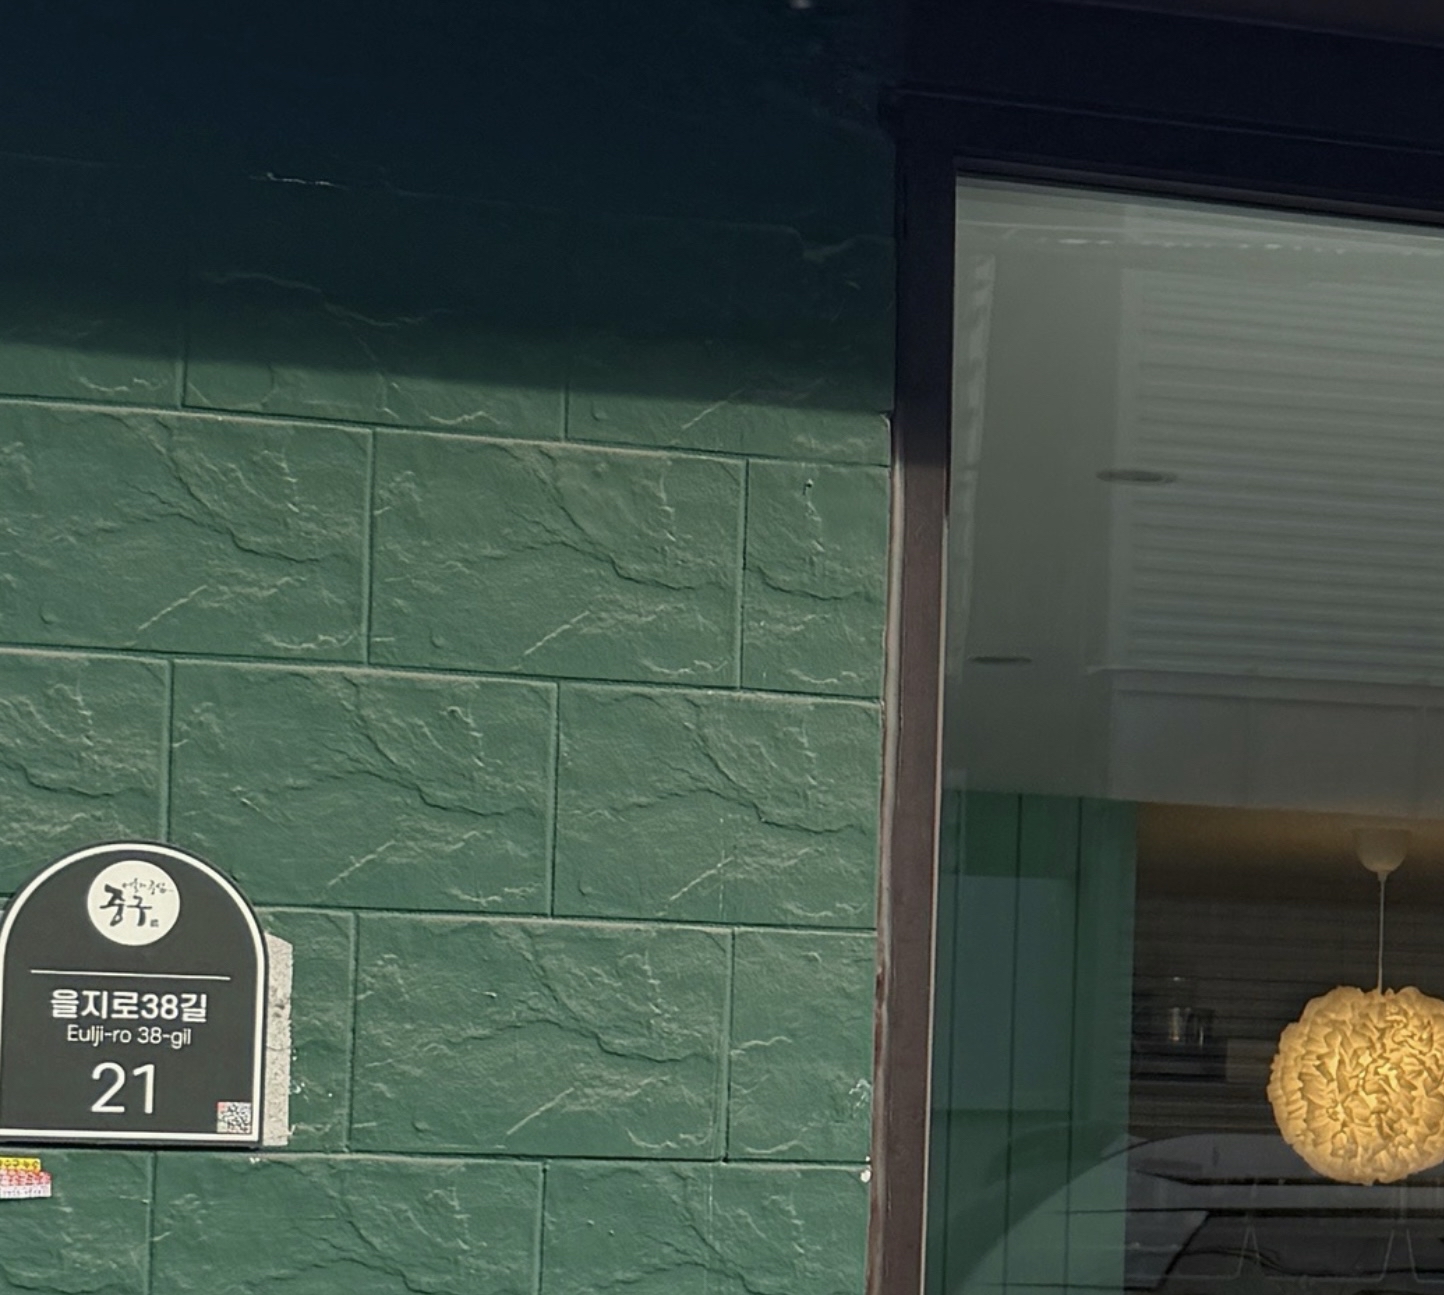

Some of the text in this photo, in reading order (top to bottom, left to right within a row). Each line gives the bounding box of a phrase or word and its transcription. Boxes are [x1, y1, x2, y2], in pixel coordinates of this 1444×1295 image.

[99, 883, 152, 927] 중구
[51, 988, 208, 1023] 을지로38길
[67, 1024, 192, 1050] Eulji-ro 38-gil
[91, 1061, 155, 1114] 21
